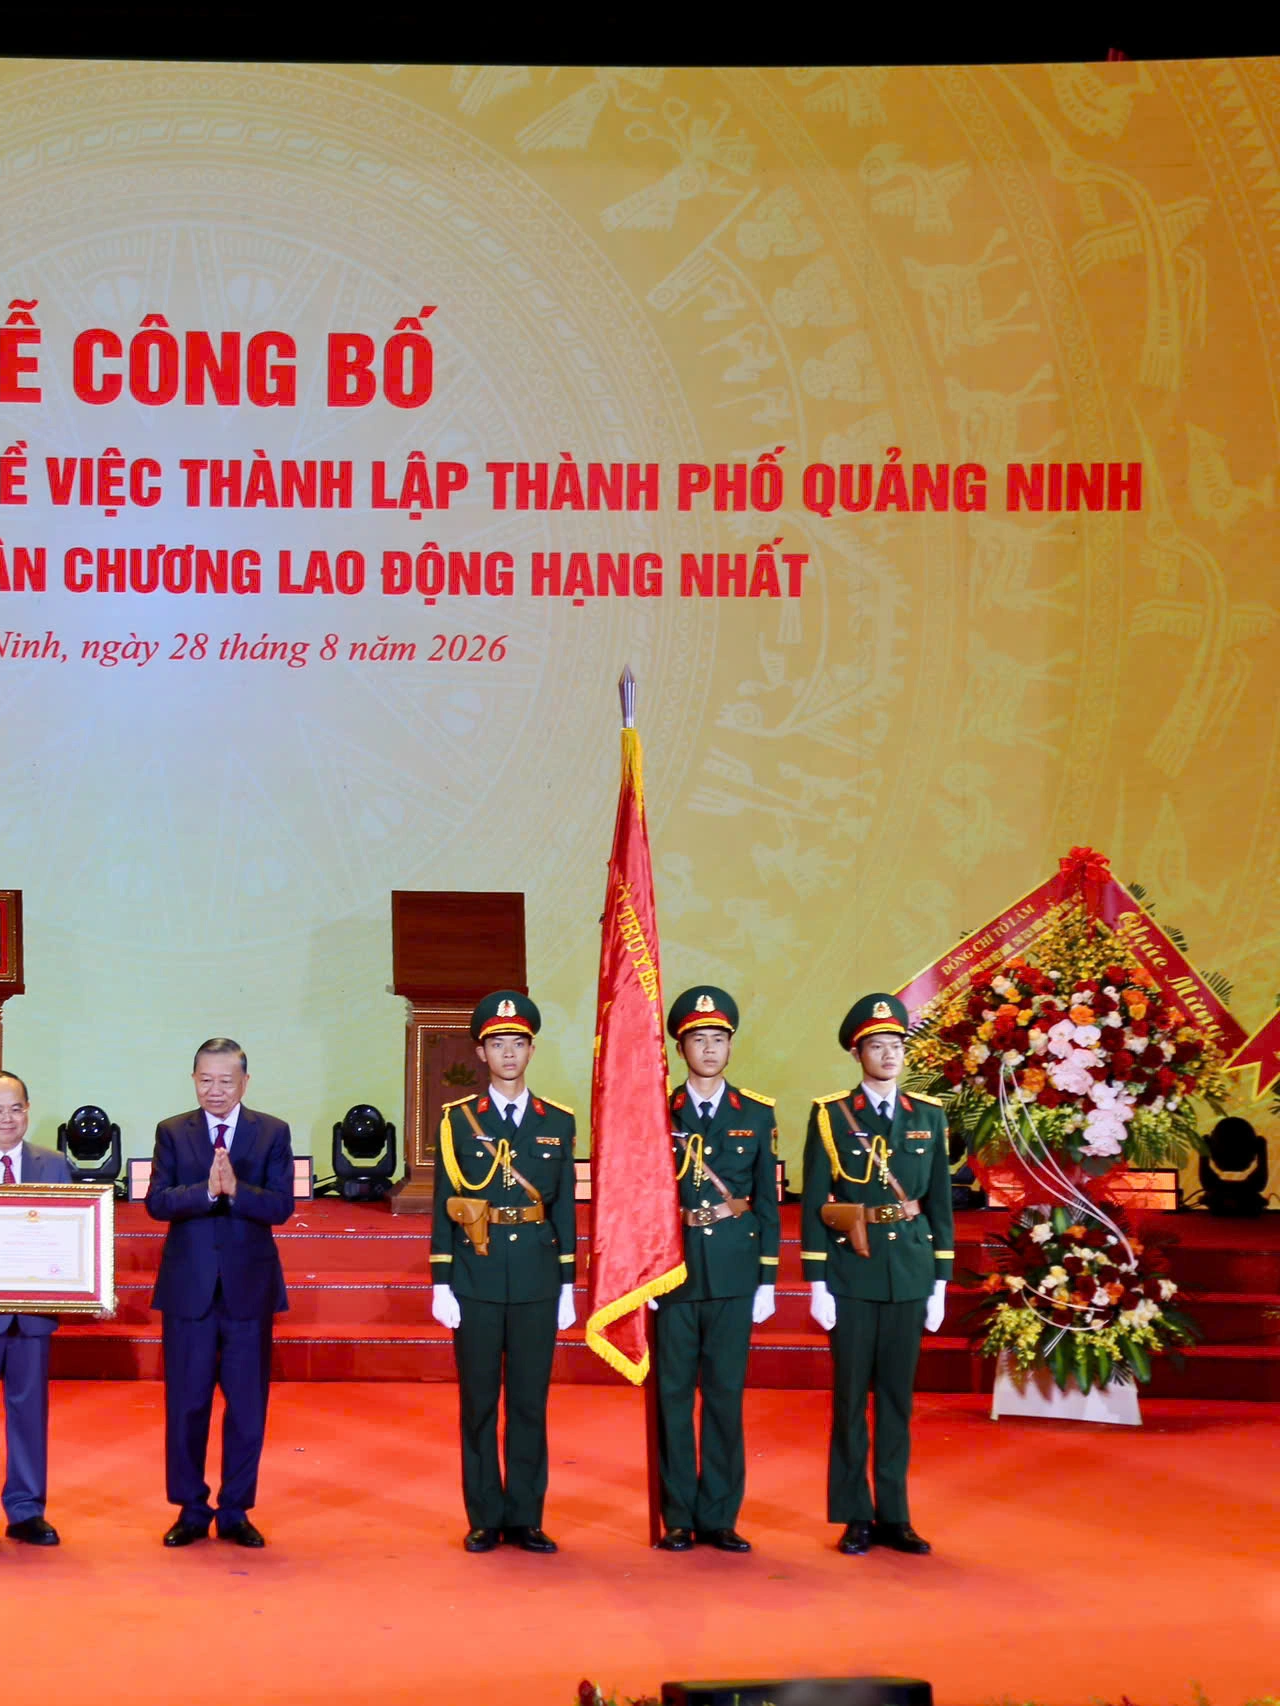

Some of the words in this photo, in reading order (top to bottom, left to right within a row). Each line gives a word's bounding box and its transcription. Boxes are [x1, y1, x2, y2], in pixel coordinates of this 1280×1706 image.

[74, 313, 297, 408] CÔNG
[328, 305, 438, 410] BỐ
[47, 447, 162, 518] VIỆC
[181, 450, 353, 509] THÀNH
[373, 451, 469, 519] LẬP
[487, 452, 659, 512] THÀNH
[678, 446, 785, 513] PHỐ
[803, 446, 988, 519] QUẢNG
[1007, 461, 1144, 513] NINH
[65, 544, 261, 595] CHƯƠNG
[280, 550, 365, 596] LAO
[382, 541, 514, 607] ĐỘNG
[532, 552, 663, 608] HẠNG
[681, 537, 810, 599] NHẤT
[82, 634, 159, 668] ngày
[169, 633, 209, 661] 28
[220, 634, 311, 668] tháng
[320, 634, 340, 661] 8
[350, 636, 417, 662] năm
[429, 634, 508, 662] 2026
[940, 949, 974, 976] ĐỒNG
[972, 932, 995, 953] CHÍ
[994, 921, 1010, 938] TÔ
[1008, 903, 1036, 927] LÂM
